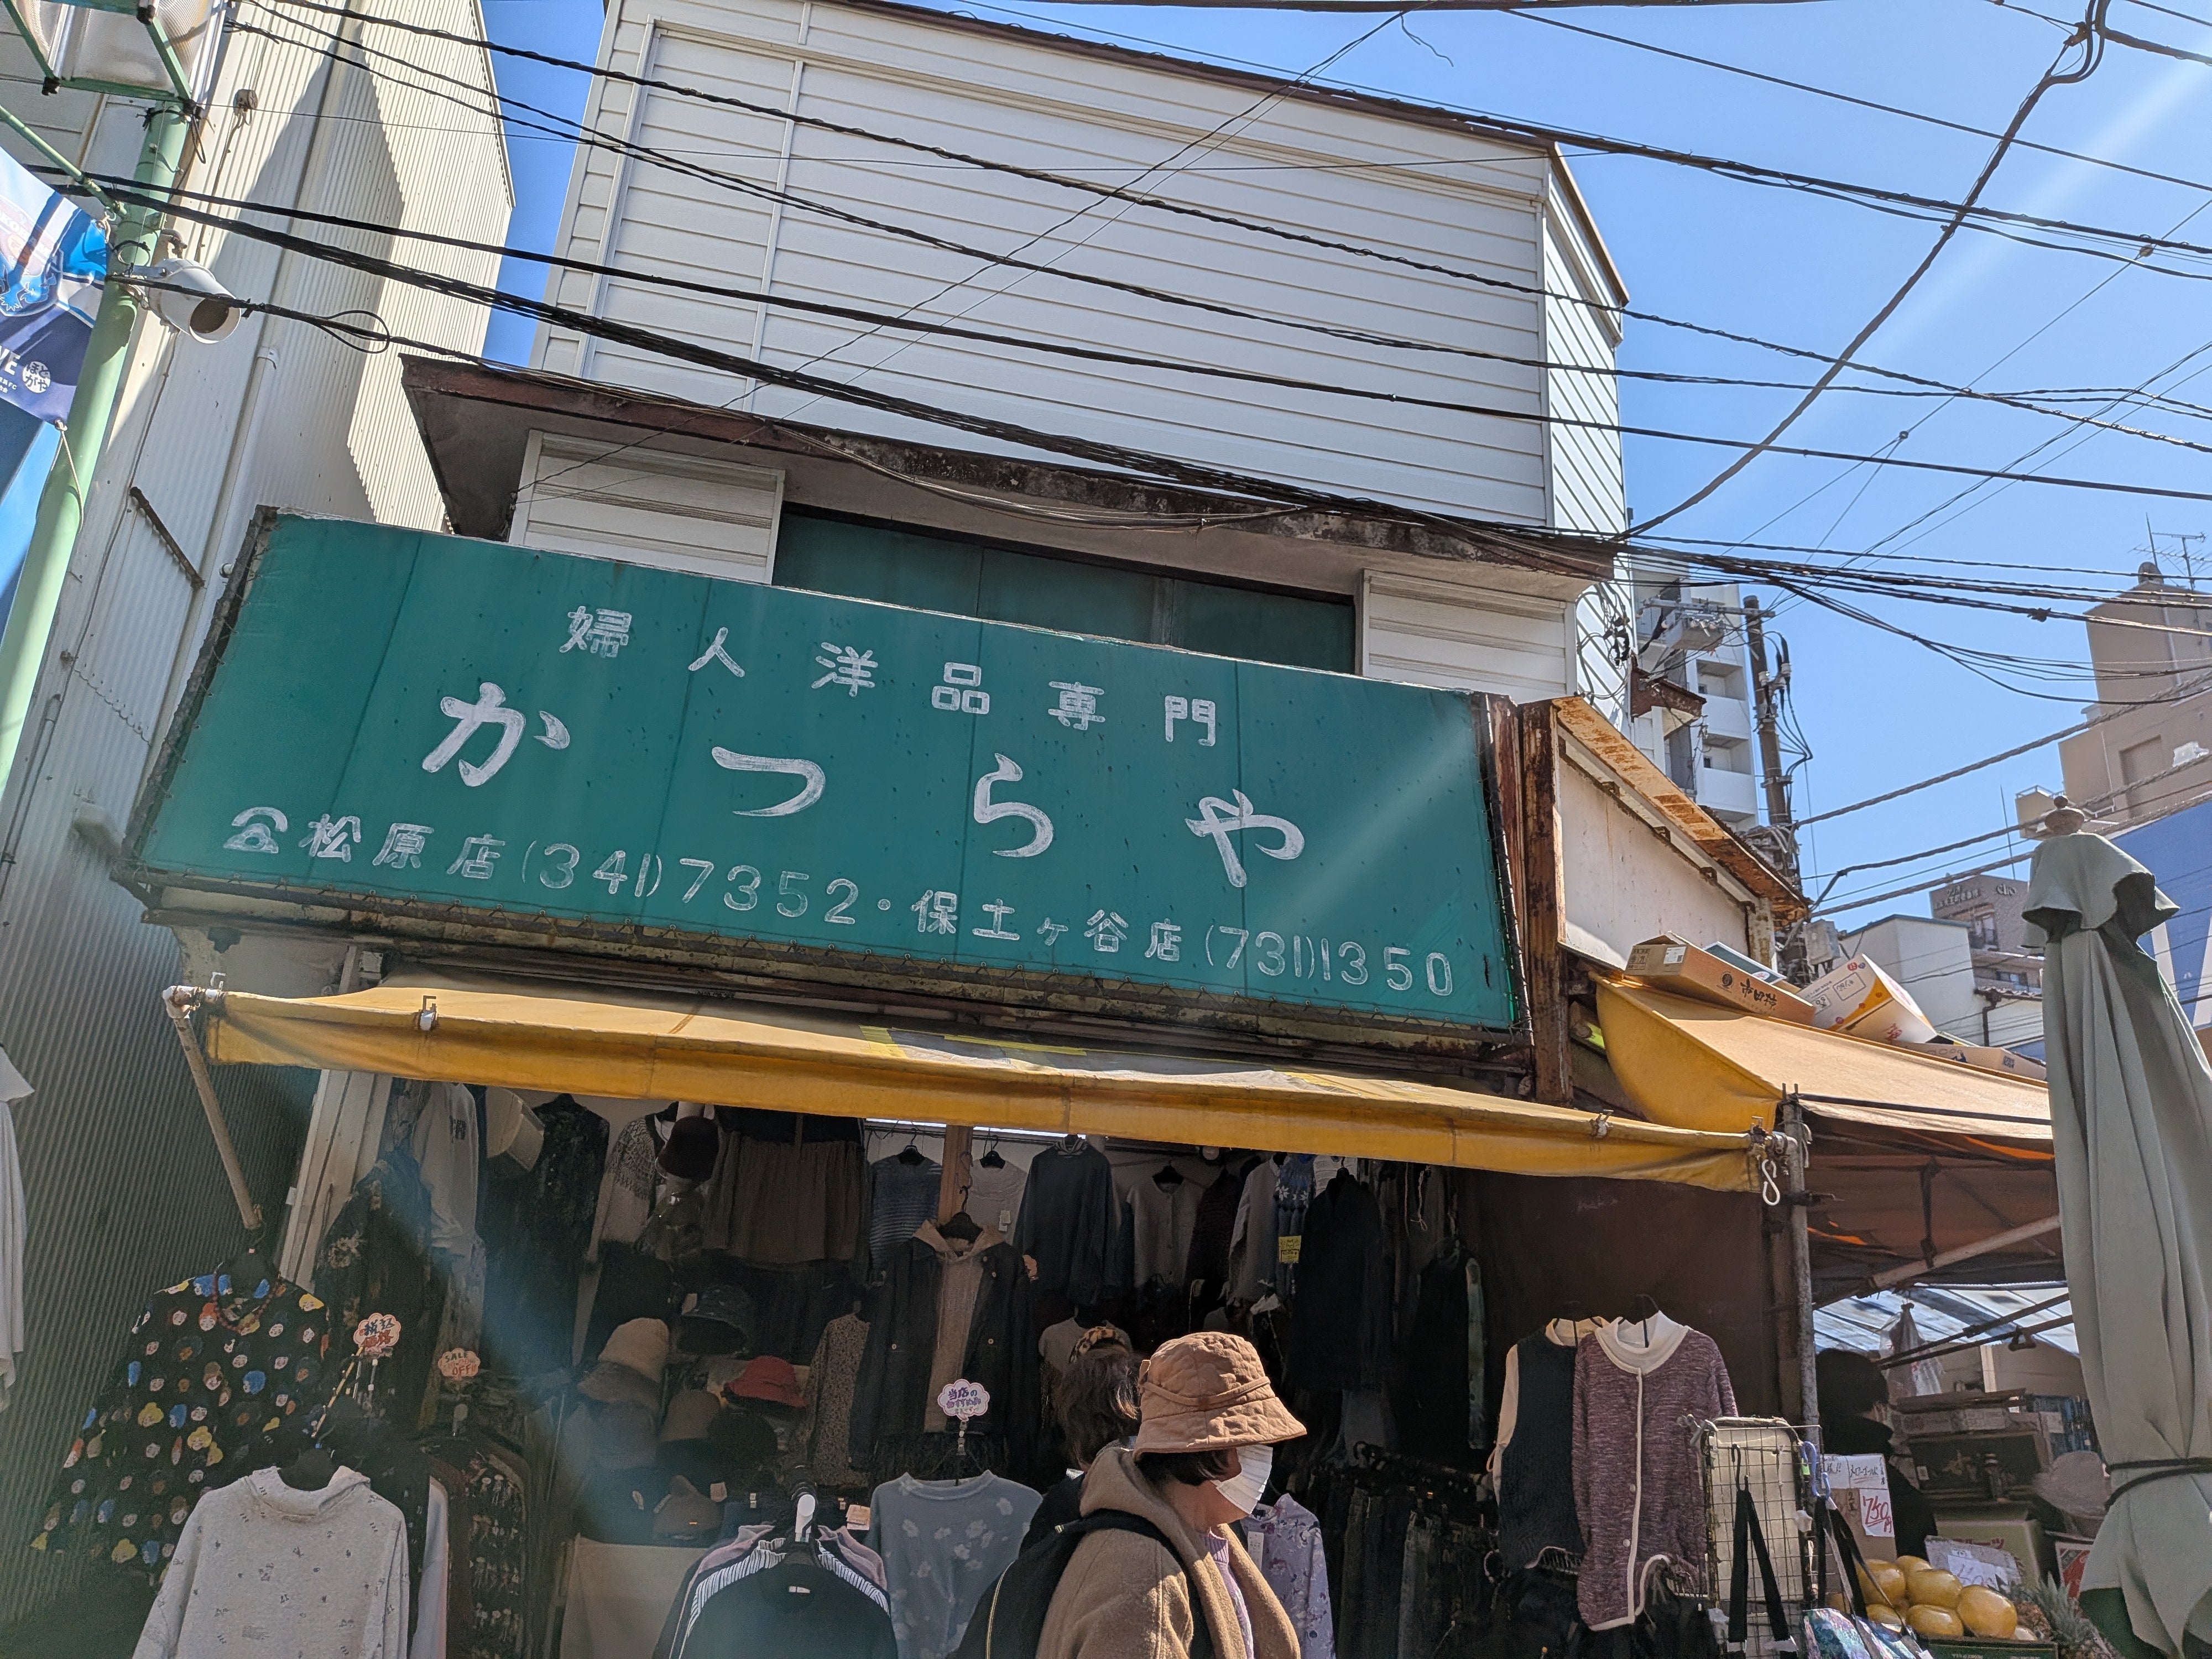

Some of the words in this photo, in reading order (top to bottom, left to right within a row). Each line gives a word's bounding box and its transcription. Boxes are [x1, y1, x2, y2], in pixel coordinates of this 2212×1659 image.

[422, 682, 1305, 887] かつらや
[445, 1352, 468, 1363] SALE
[948, 1386, 978, 1401] 当店の
